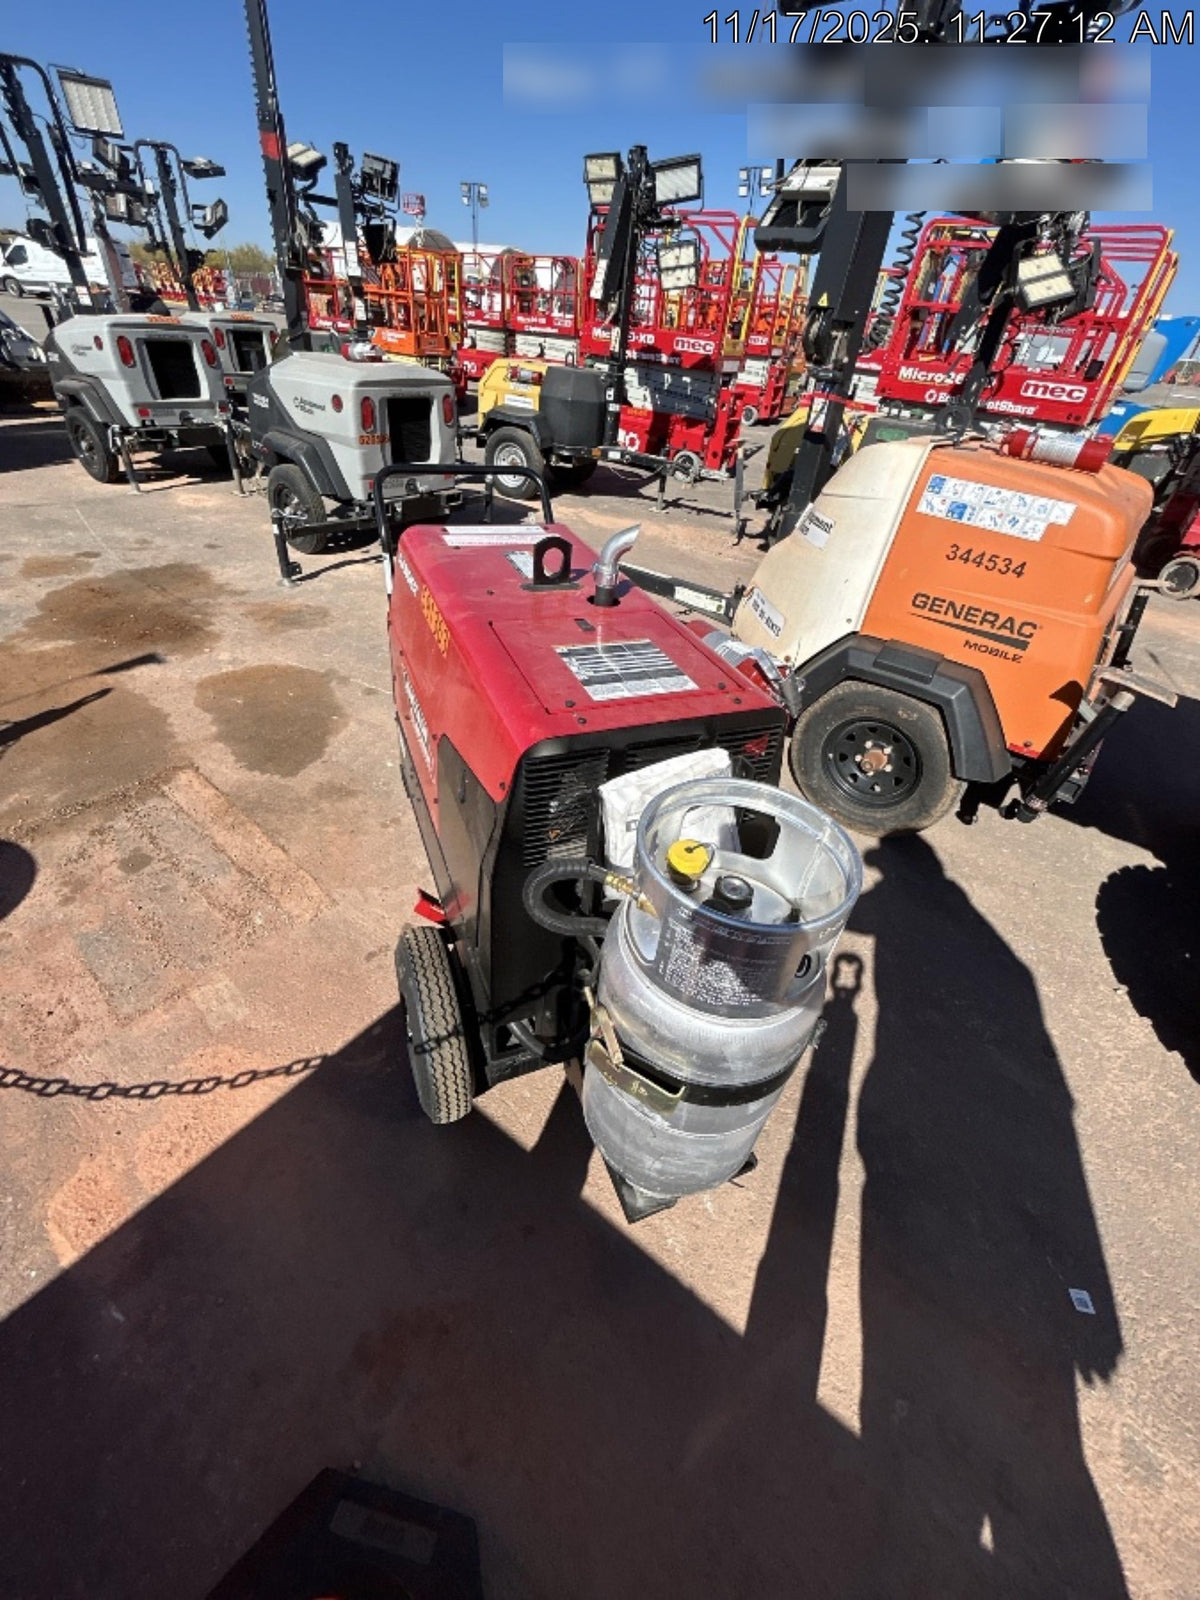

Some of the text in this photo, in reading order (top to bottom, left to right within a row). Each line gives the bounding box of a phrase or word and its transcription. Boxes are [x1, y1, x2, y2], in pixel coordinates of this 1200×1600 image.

[674, 337, 714, 353] mec
[1024, 382, 1087, 401] mec
[945, 544, 1027, 578] 344534
[911, 592, 1038, 640] GENERAC
[963, 639, 1023, 664] MOBILE
